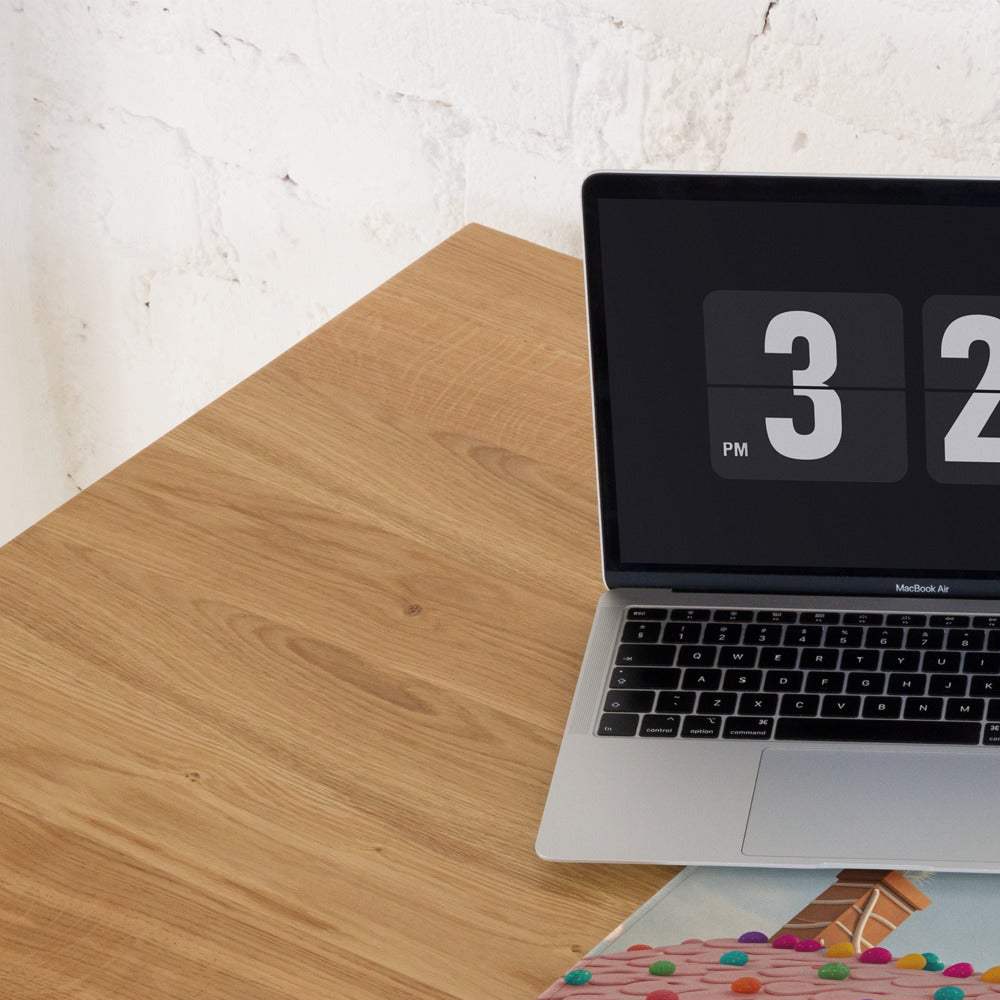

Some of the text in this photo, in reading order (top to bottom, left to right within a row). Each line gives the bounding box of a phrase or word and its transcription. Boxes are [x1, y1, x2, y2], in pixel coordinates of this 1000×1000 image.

[764, 310, 843, 461] 3
[722, 442, 749, 457] PM
[895, 583, 950, 593] MacBook Air
[693, 652, 702, 660] Q
[821, 678, 828, 686] F
[862, 679, 870, 687] G
[878, 703, 886, 711] B
